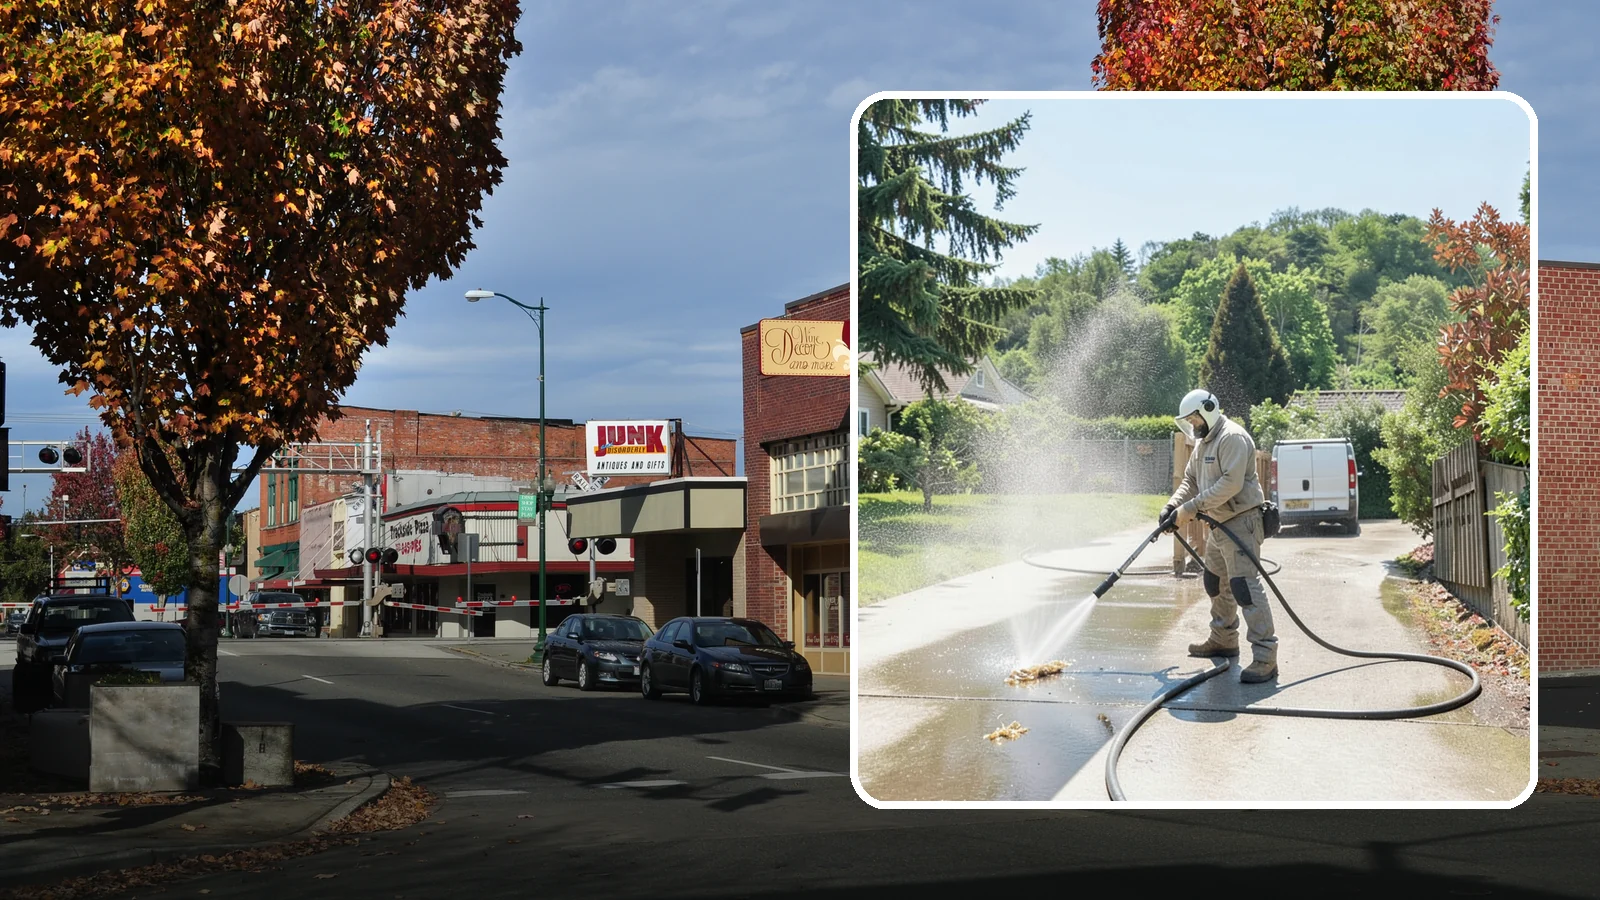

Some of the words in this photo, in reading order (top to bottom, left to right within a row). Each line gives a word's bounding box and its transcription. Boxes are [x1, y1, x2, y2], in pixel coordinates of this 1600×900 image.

[595, 425, 665, 457] JUNK
[607, 446, 646, 454] DISORDERLY
[597, 461, 628, 470] ANTIQUES
[631, 461, 644, 470] AND
[646, 460, 665, 469] GIFTS
